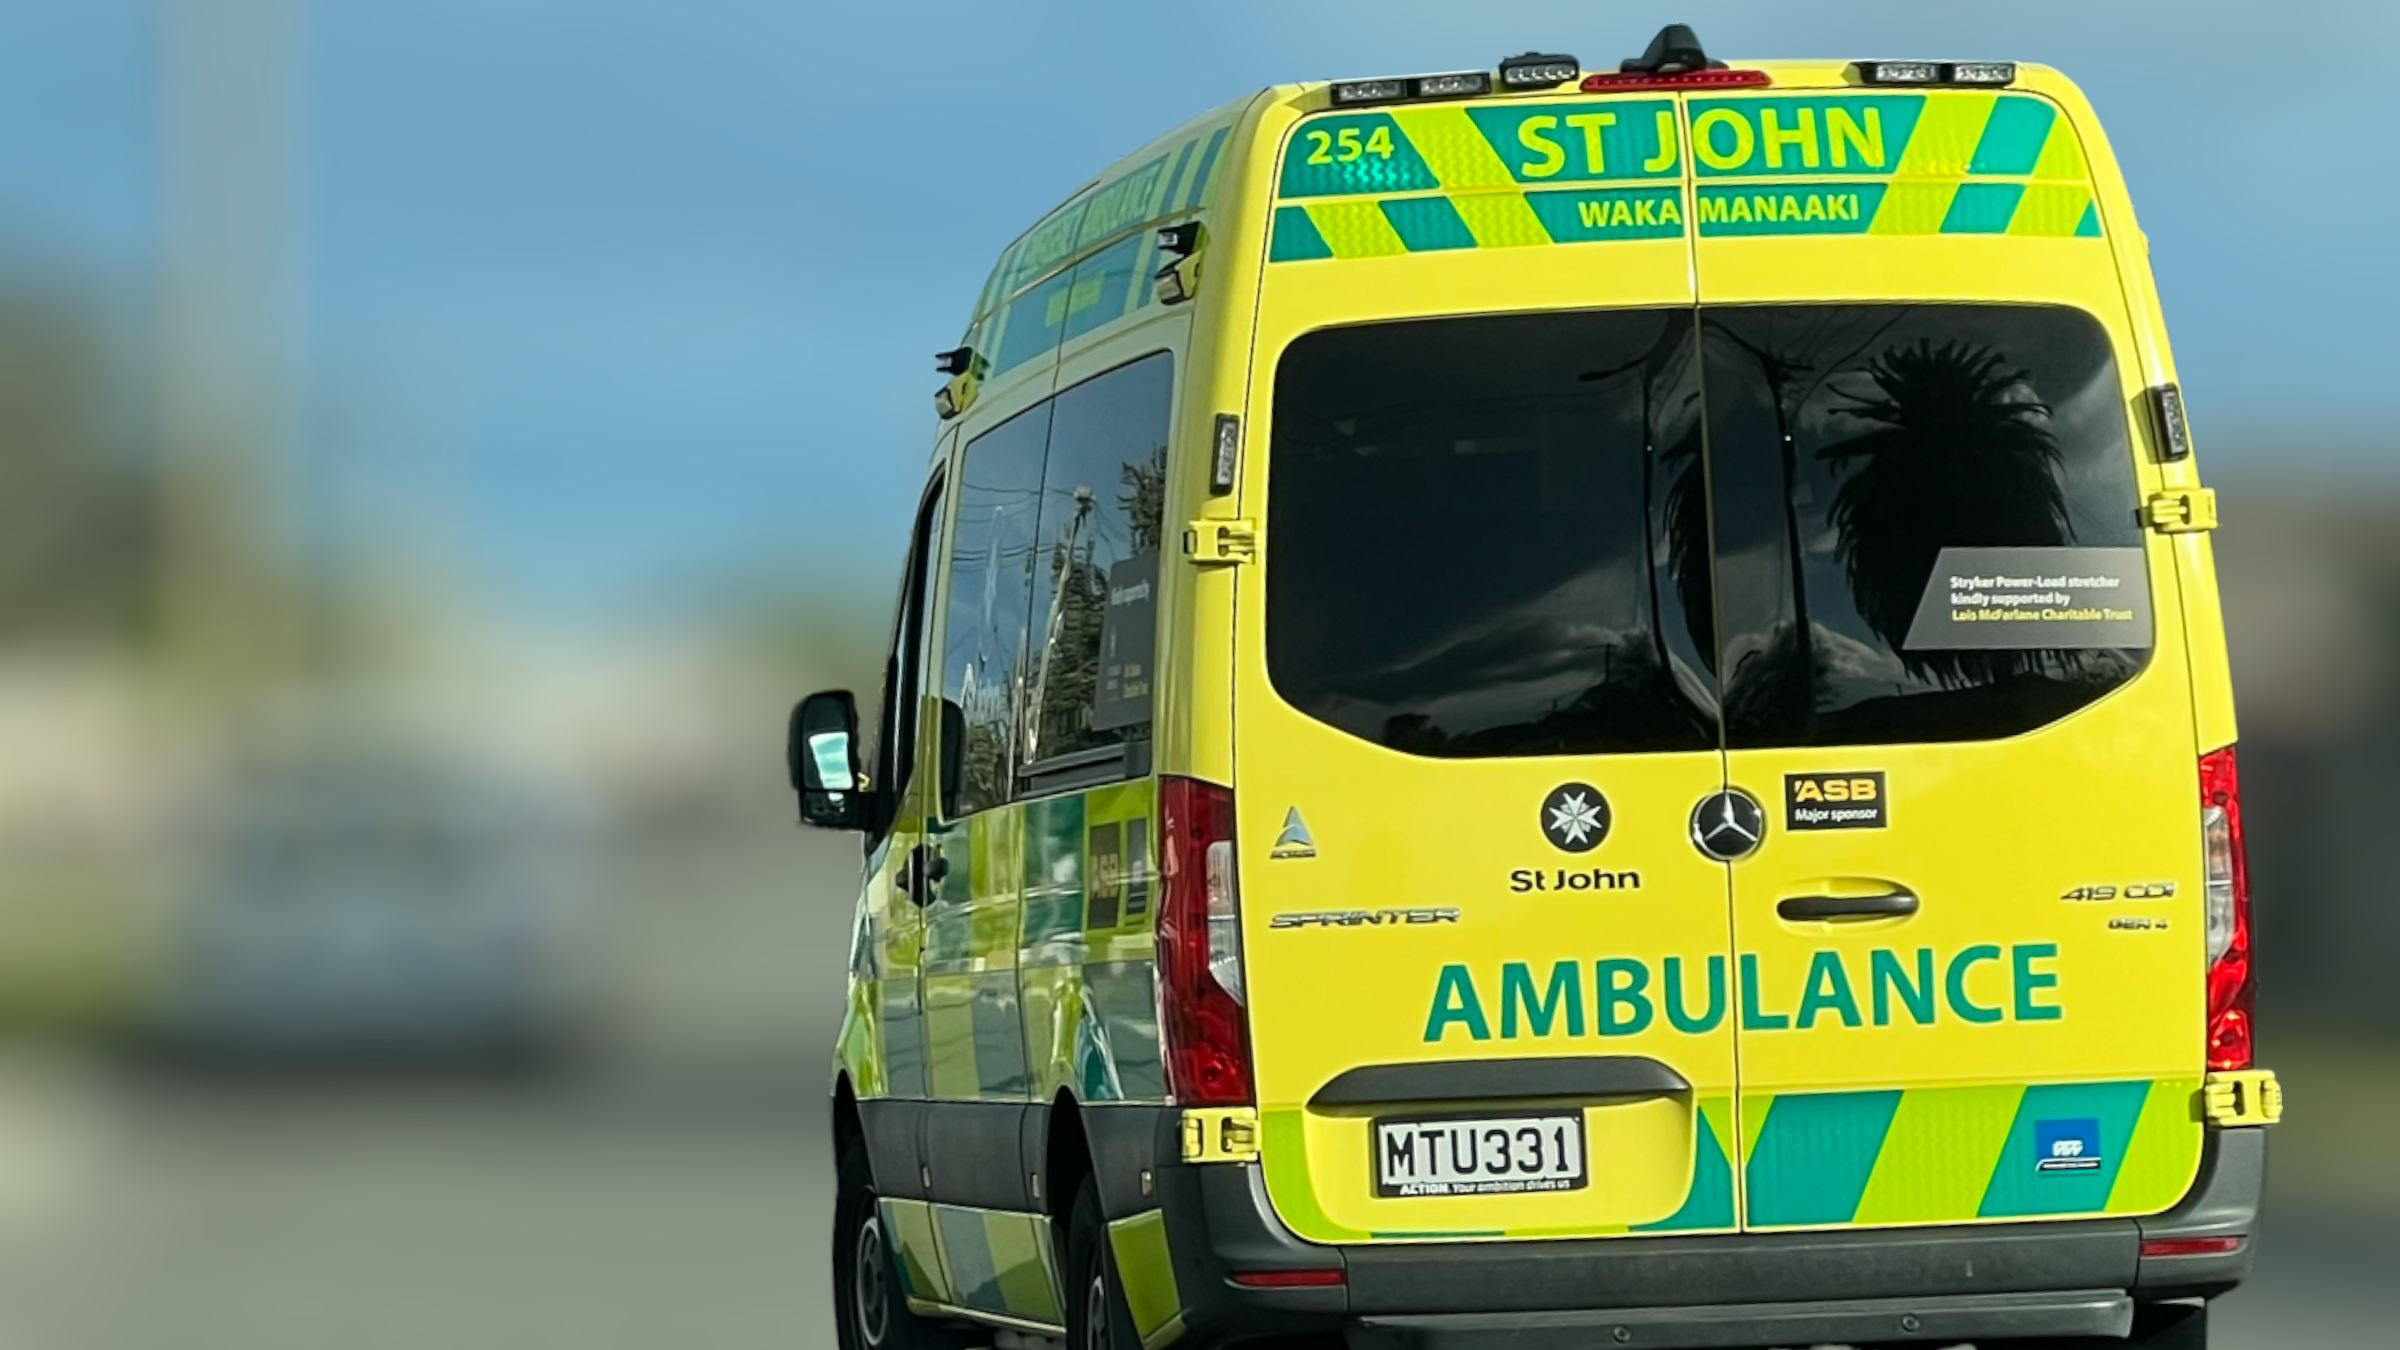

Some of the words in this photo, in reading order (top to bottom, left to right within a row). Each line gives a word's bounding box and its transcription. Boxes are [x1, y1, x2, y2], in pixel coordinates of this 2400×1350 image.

[1305, 125, 1395, 166] 254
[1517, 112, 1617, 178] ST
[1644, 107, 1885, 174] JOHN
[1578, 198, 1682, 228] WAKA
[1699, 193, 1860, 224] MANAAKI
[1949, 575, 1995, 590] Stryker
[1996, 575, 2066, 588] Power-Load
[2067, 575, 2121, 588] stretcher
[1950, 592, 1990, 607] kindly
[1991, 592, 2053, 607] supported
[2055, 592, 2071, 607] by
[1951, 609, 1977, 621] Lois
[1978, 609, 2040, 621] McFarlane
[2041, 609, 2102, 621] Charitable
[2102, 608, 2133, 620] Trust
[1794, 778, 1877, 802] ASB
[1795, 807, 1829, 824] Major
[1830, 807, 1878, 822] sponsor
[1510, 870, 1546, 892] St
[1553, 868, 1640, 891] John
[2060, 885, 2117, 901] 419
[1269, 907, 1460, 928] SPRINTER
[1423, 943, 2062, 1042] AMBULANCE
[1387, 1126, 1569, 1178] MTU331
[1476, 1181, 1525, 1193] ambition
[1526, 1180, 1556, 1191] drives
[1557, 1179, 1570, 1189] us
